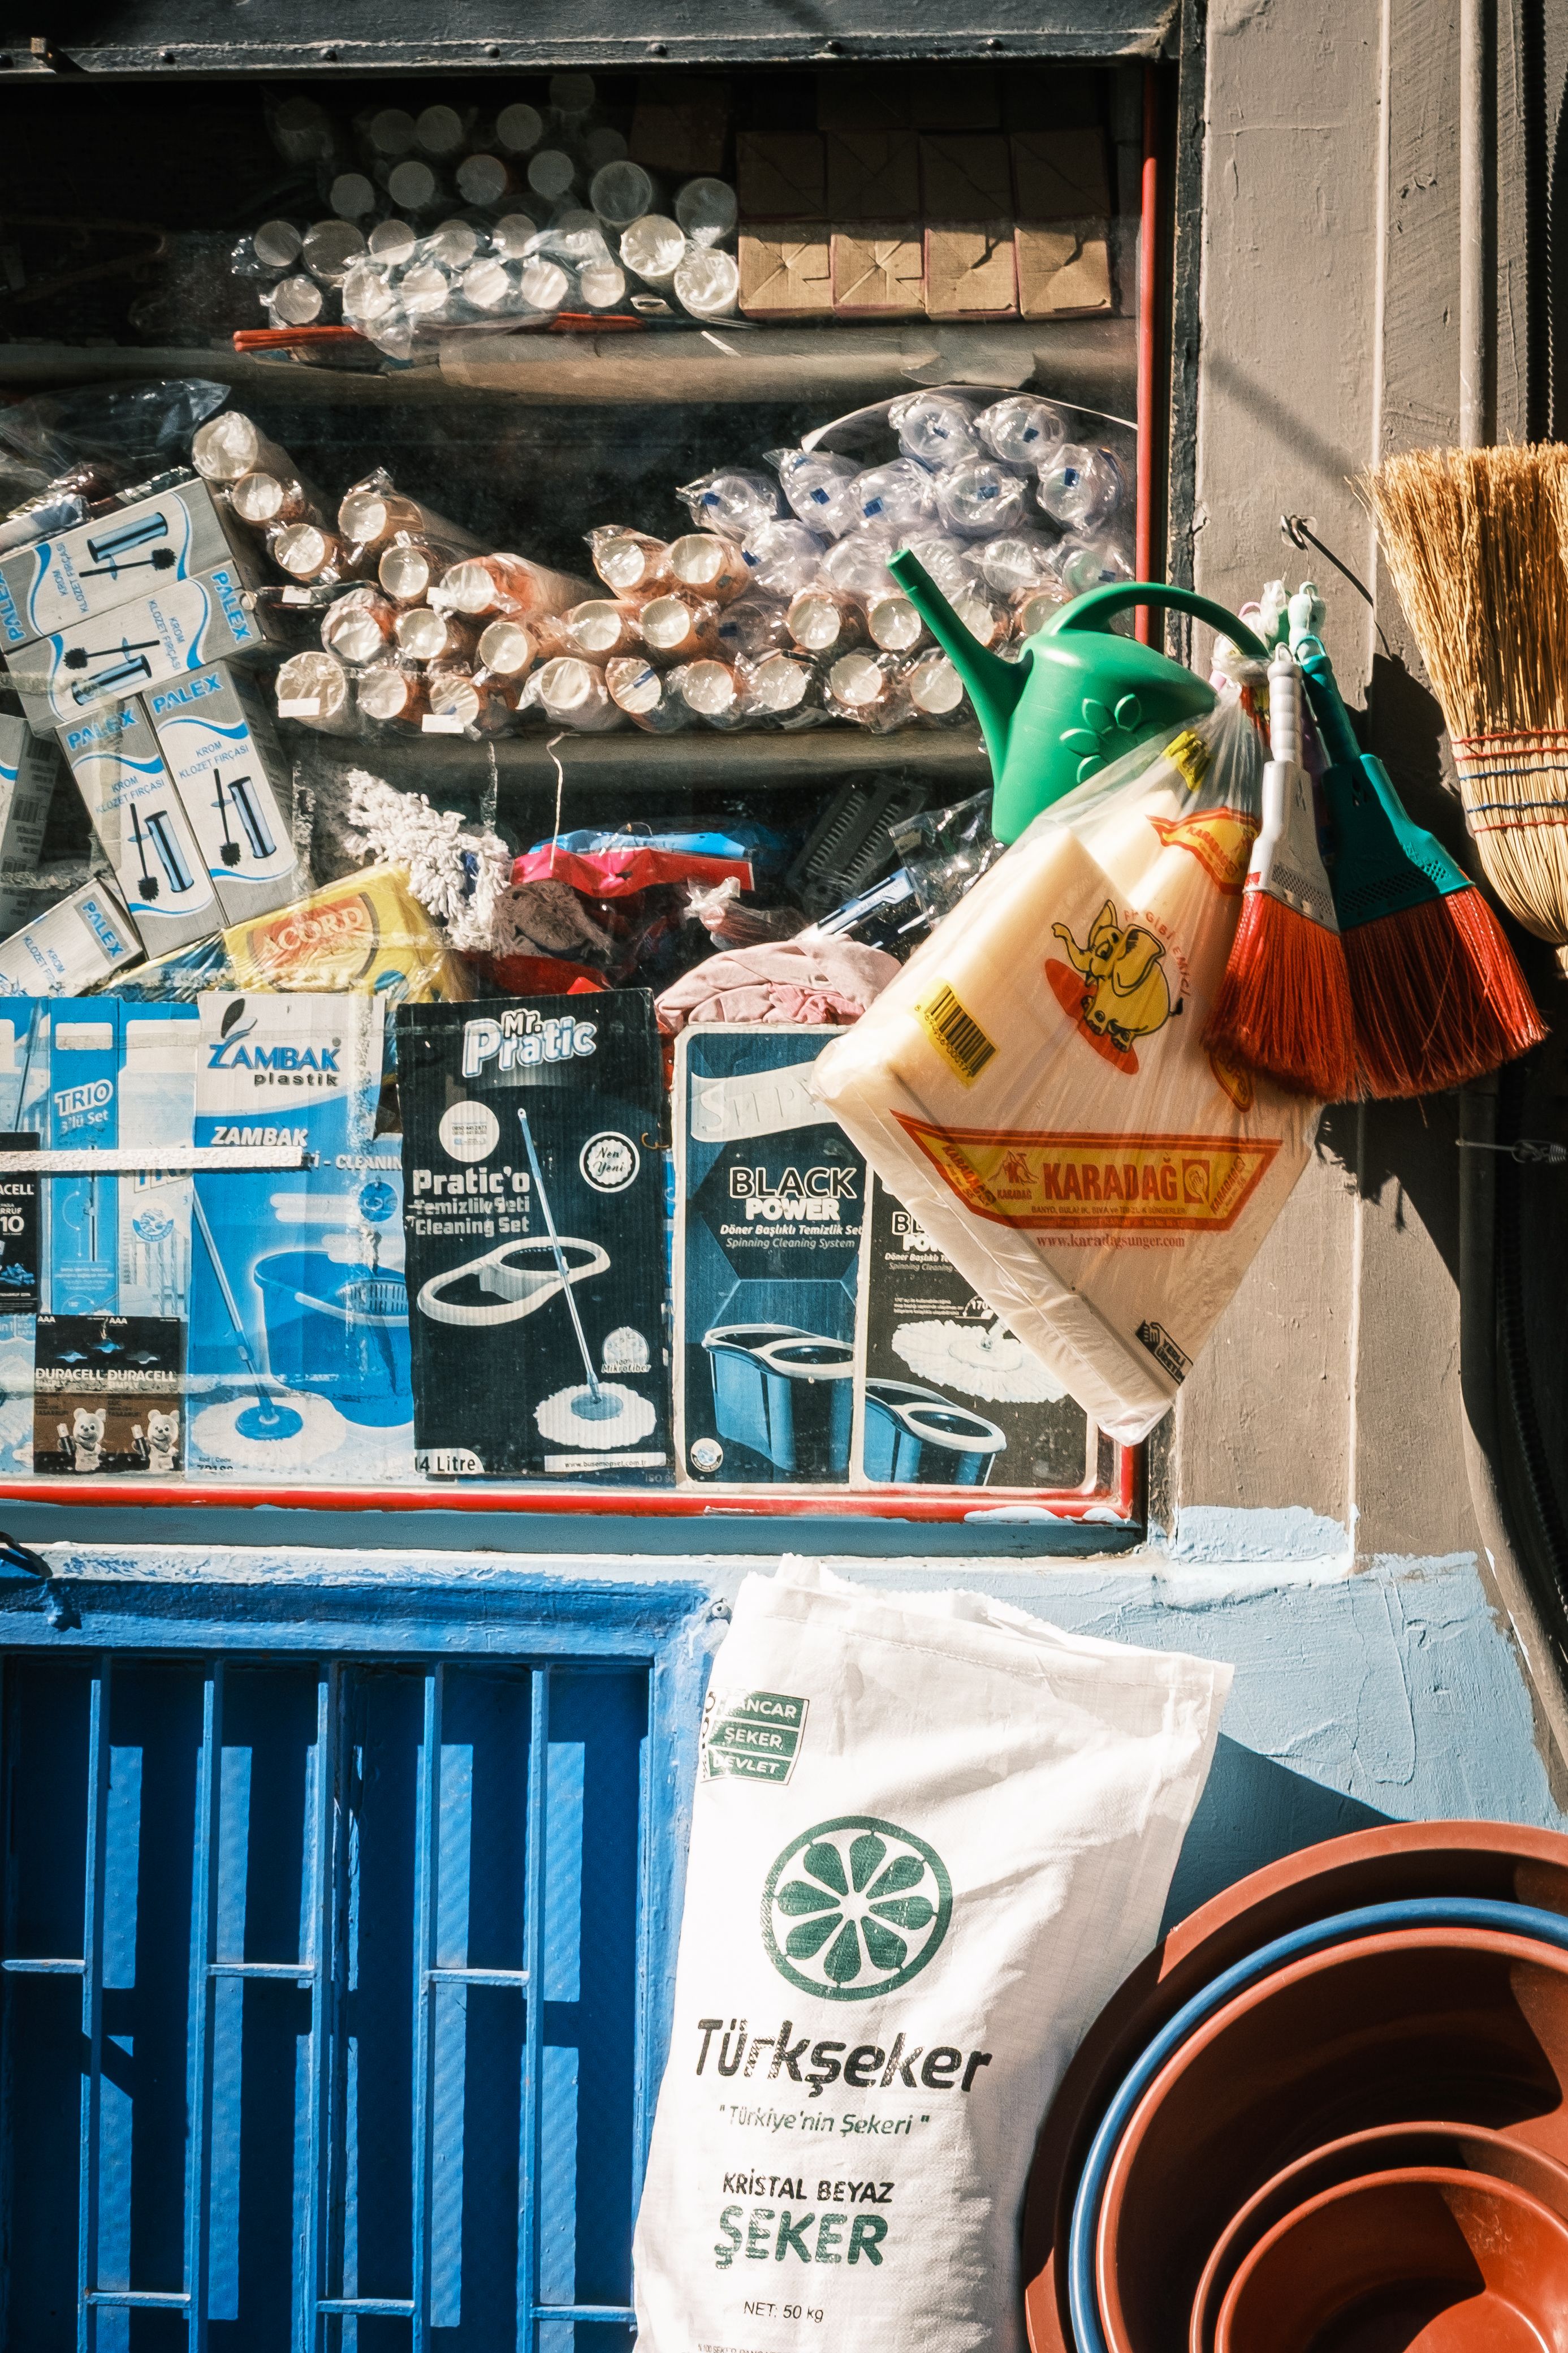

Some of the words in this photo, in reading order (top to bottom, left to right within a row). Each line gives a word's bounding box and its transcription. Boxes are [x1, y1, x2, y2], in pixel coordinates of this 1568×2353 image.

[51, 569, 68, 596] KROM
[69, 578, 89, 614] KLOZET
[211, 570, 253, 644] PALEX
[147, 599, 168, 636] KLOZET
[163, 636, 181, 671] FIRÇASI
[169, 617, 185, 644] KROM
[151, 673, 224, 715] PALEX
[66, 708, 139, 751] PALEX
[178, 760, 213, 779] KLOZET
[213, 744, 249, 768] FIRÇASI
[196, 740, 222, 759] KROM
[111, 775, 139, 793] KROM
[129, 778, 165, 802] FIRÇASI
[82, 900, 125, 959] PALEX
[503, 1010, 543, 1040] Mr.
[208, 1044, 340, 1072] ZAMBAK
[463, 1016, 597, 1078] Pratic
[254, 1074, 338, 1087] plastik
[56, 1080, 111, 1116] TRIO
[87, 1110, 109, 1125] Set
[211, 1126, 309, 1147] ZAMBAK
[412, 1166, 530, 1196] Pratic'o
[729, 1166, 857, 1199] BLACK
[1042, 1155, 1177, 1201] KARADAĞ
[745, 1198, 841, 1221] POWER
[0, 1216, 25, 1232] 10
[415, 1217, 495, 1238] Cleaning
[498, 1216, 530, 1234] Set
[720, 1224, 754, 1235] Döner
[798, 1223, 843, 1236] Temizlik
[725, 1237, 770, 1250] Spinning
[772, 1237, 817, 1251] Cleaning
[819, 1238, 856, 1251] System
[36, 1368, 104, 1381] DURACELL
[107, 1369, 176, 1382] DURACELL
[437, 1455, 476, 1472] Litre
[712, 1753, 780, 1774] DEVLET
[696, 2018, 993, 2098] Türkşeker
[723, 2168, 808, 2200] KRİSTAL
[817, 2180, 895, 2204] BEYAZ
[714, 2204, 888, 2270] ŞEKER
[744, 2300, 779, 2318] NET:
[783, 2303, 802, 2320] 50
[807, 2305, 824, 2323] kg
